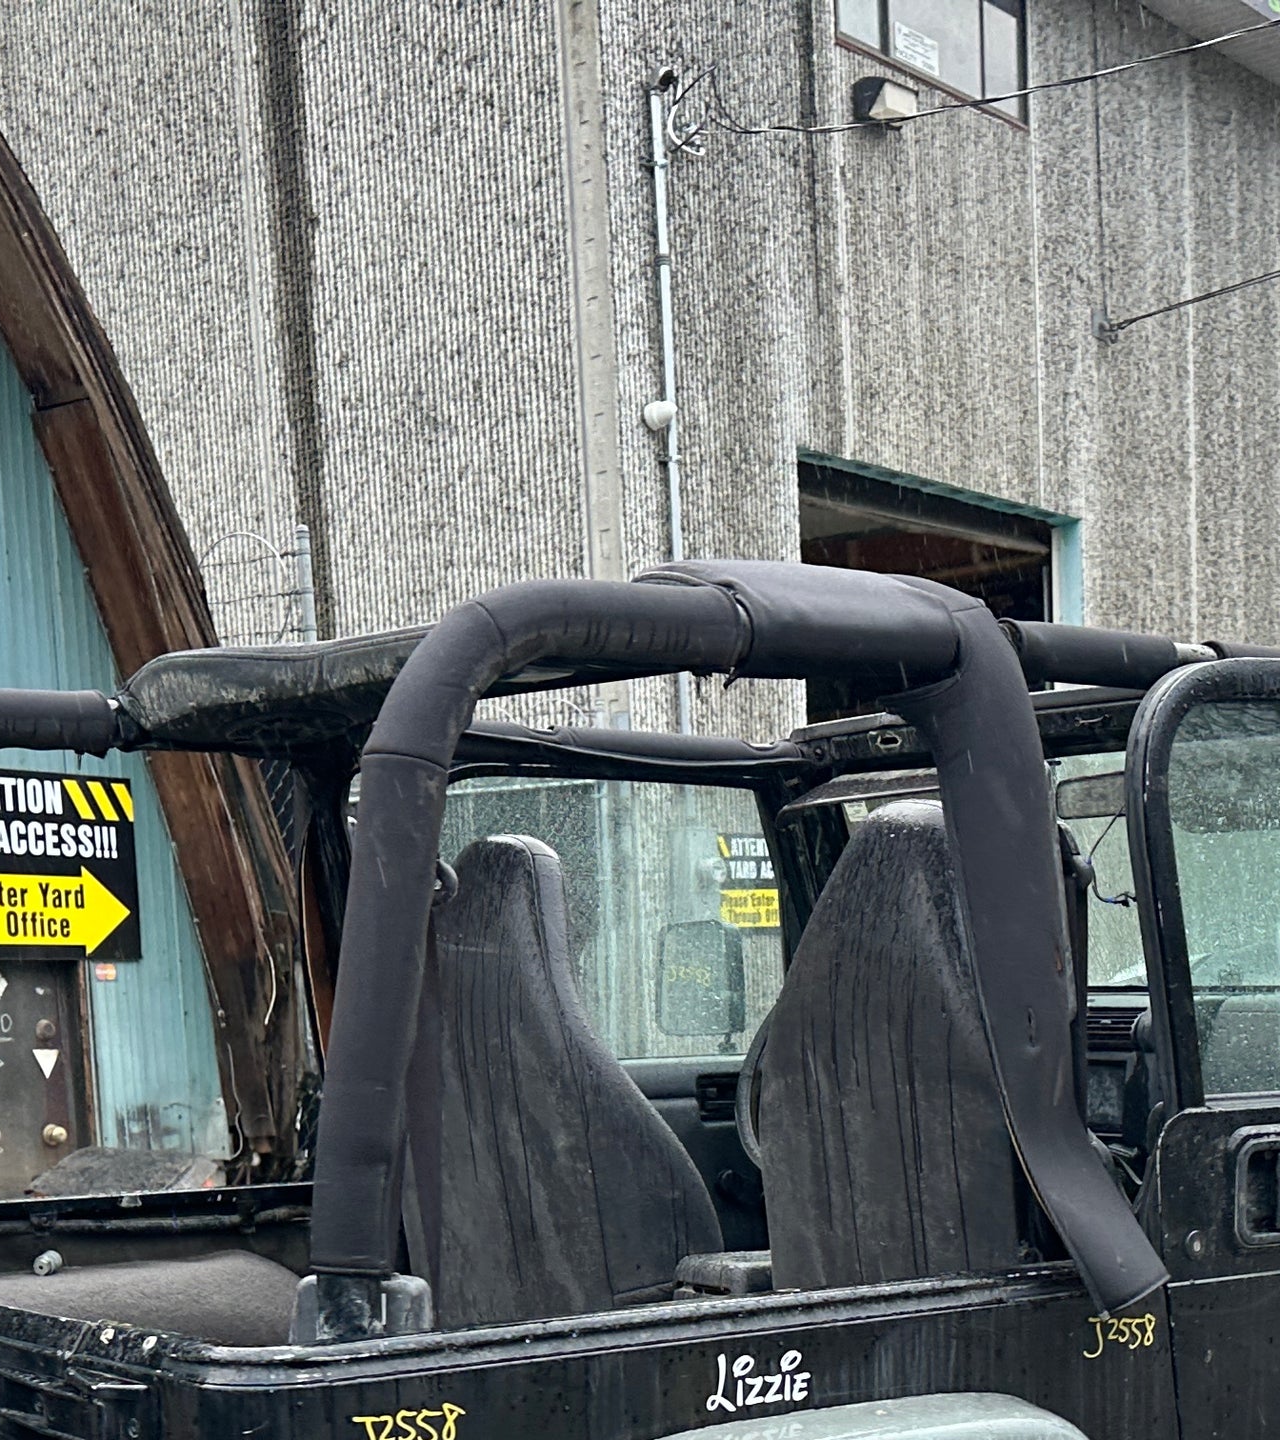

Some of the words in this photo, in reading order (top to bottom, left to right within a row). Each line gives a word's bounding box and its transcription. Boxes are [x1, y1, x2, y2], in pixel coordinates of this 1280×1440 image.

[729, 860, 758, 880] YARD
[38, 882, 86, 909] Yard
[6, 911, 71, 938] Office
[1083, 1312, 1157, 1359] J2558
